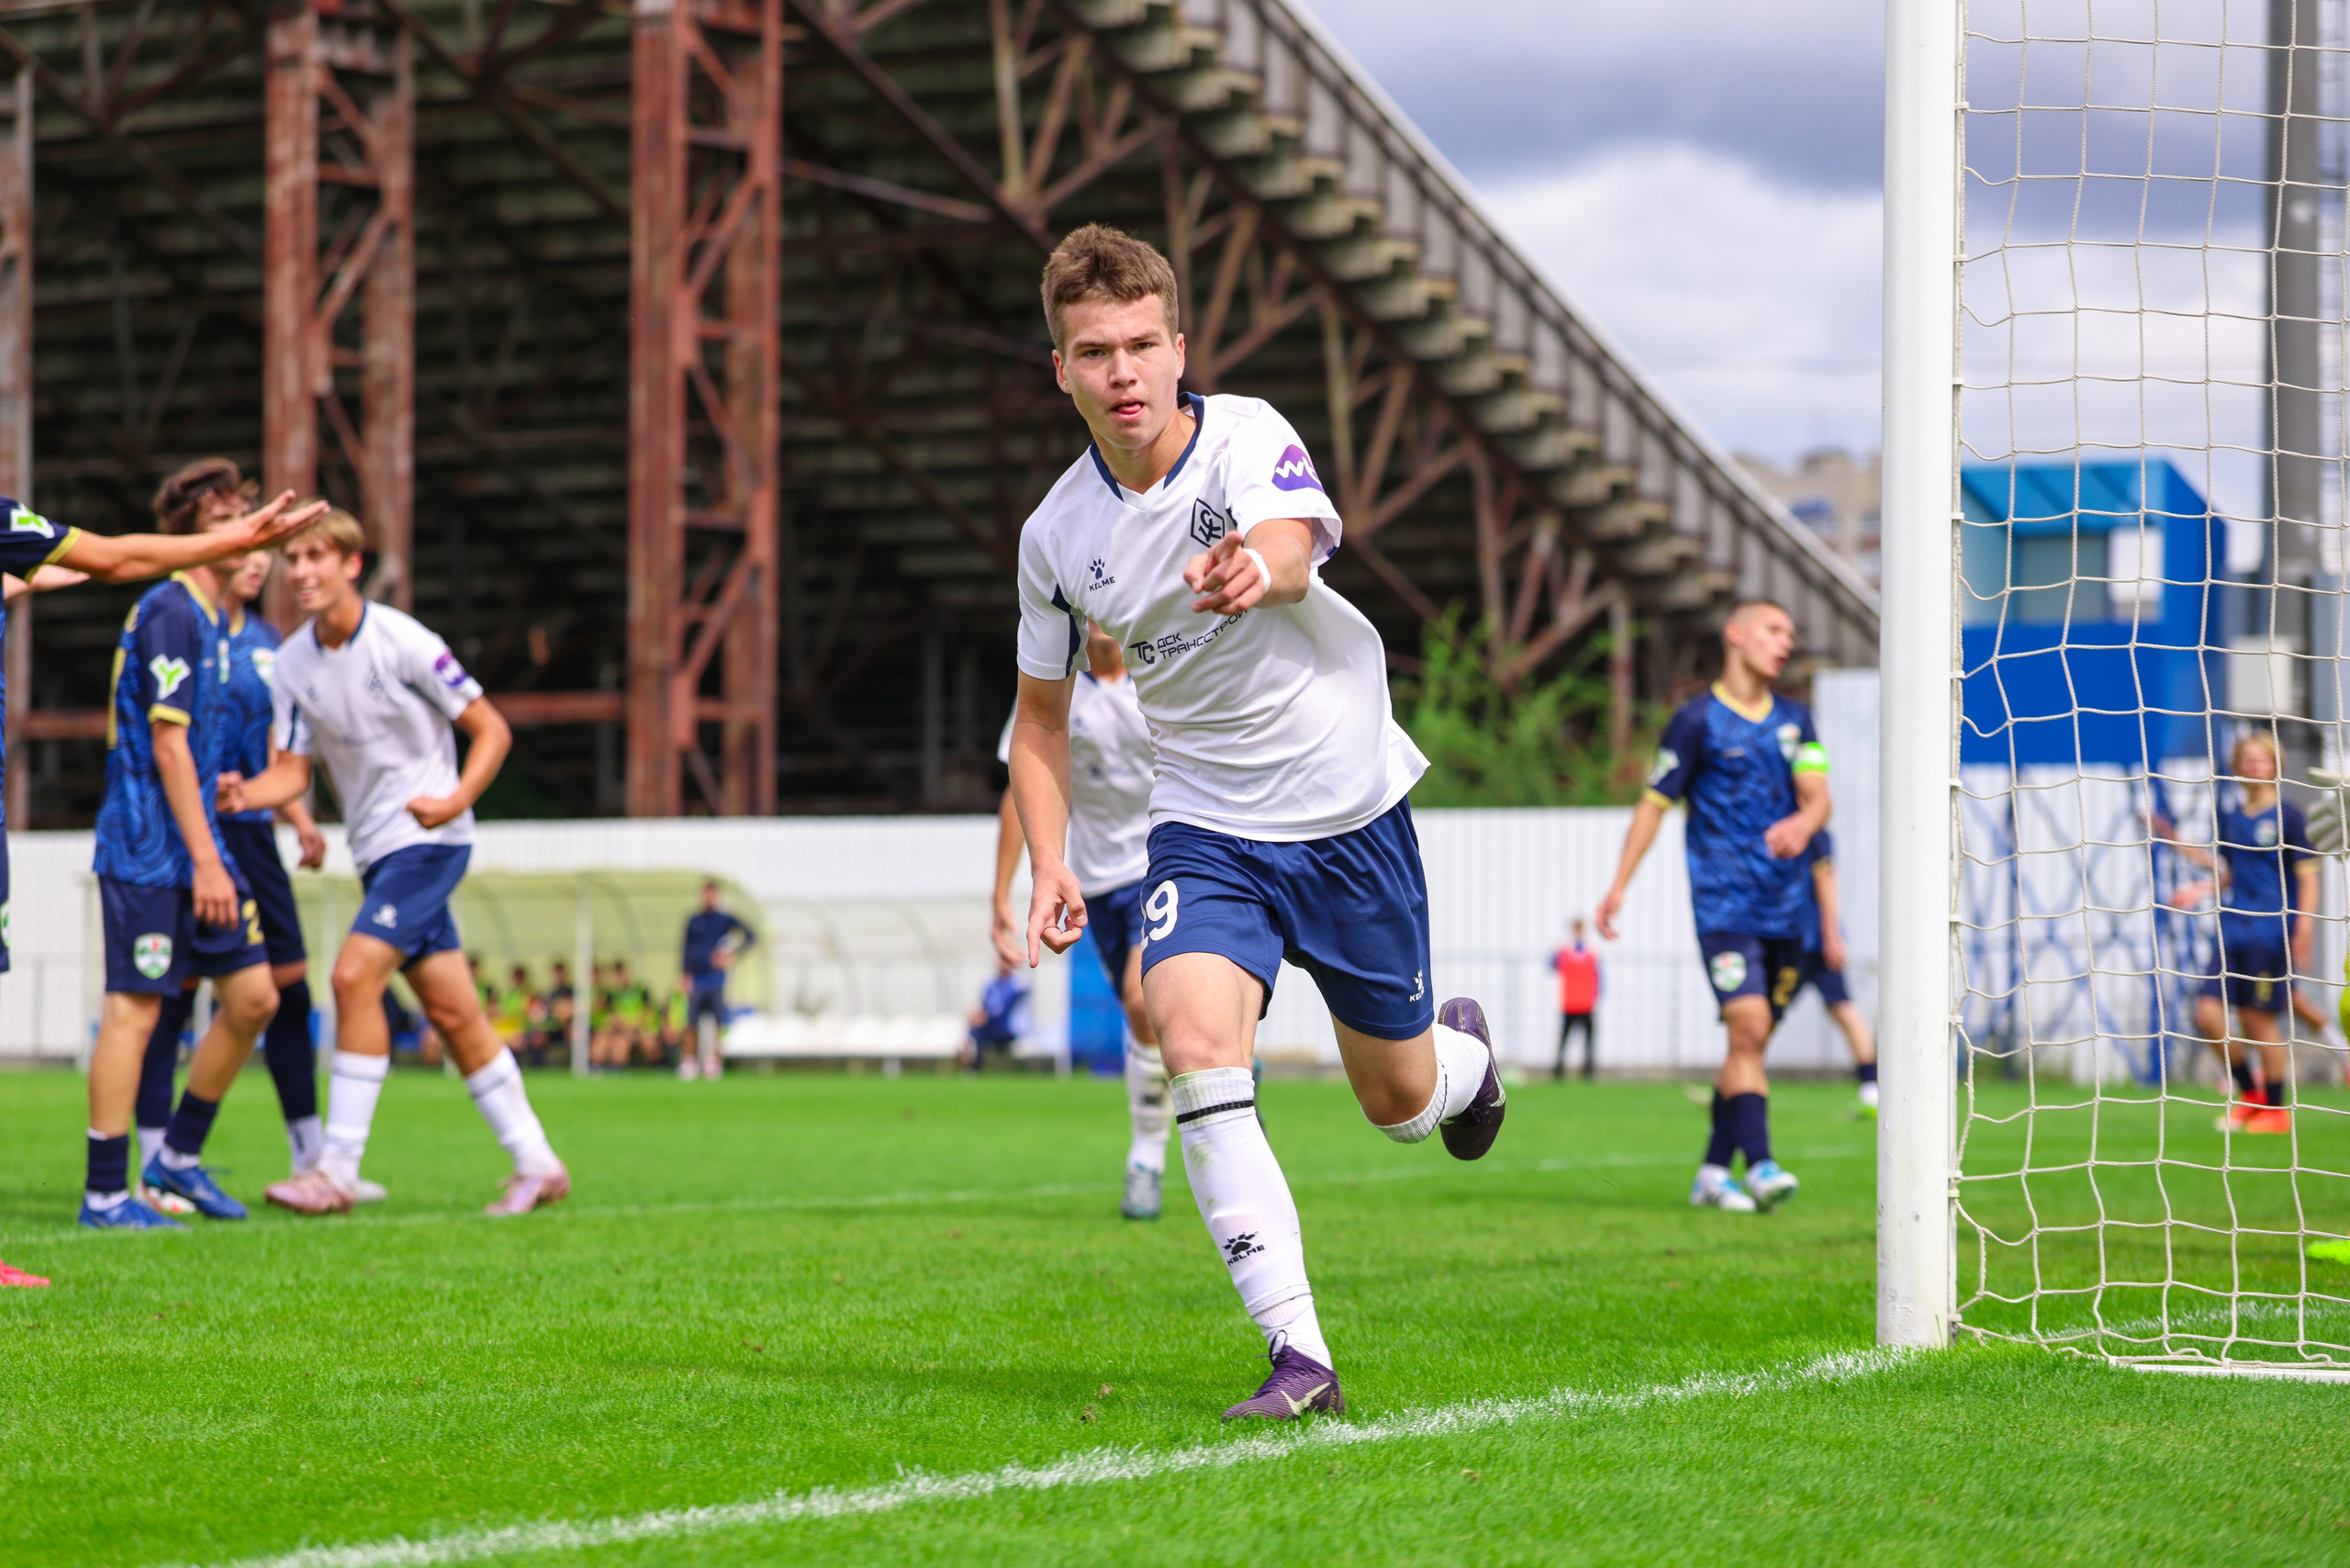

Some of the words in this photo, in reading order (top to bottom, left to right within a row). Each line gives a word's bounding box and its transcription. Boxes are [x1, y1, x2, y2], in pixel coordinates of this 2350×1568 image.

[1089, 576, 1116, 592] KELME
[1157, 633, 1183, 650] ДСК
[1226, 1244, 1265, 1266] KELME
